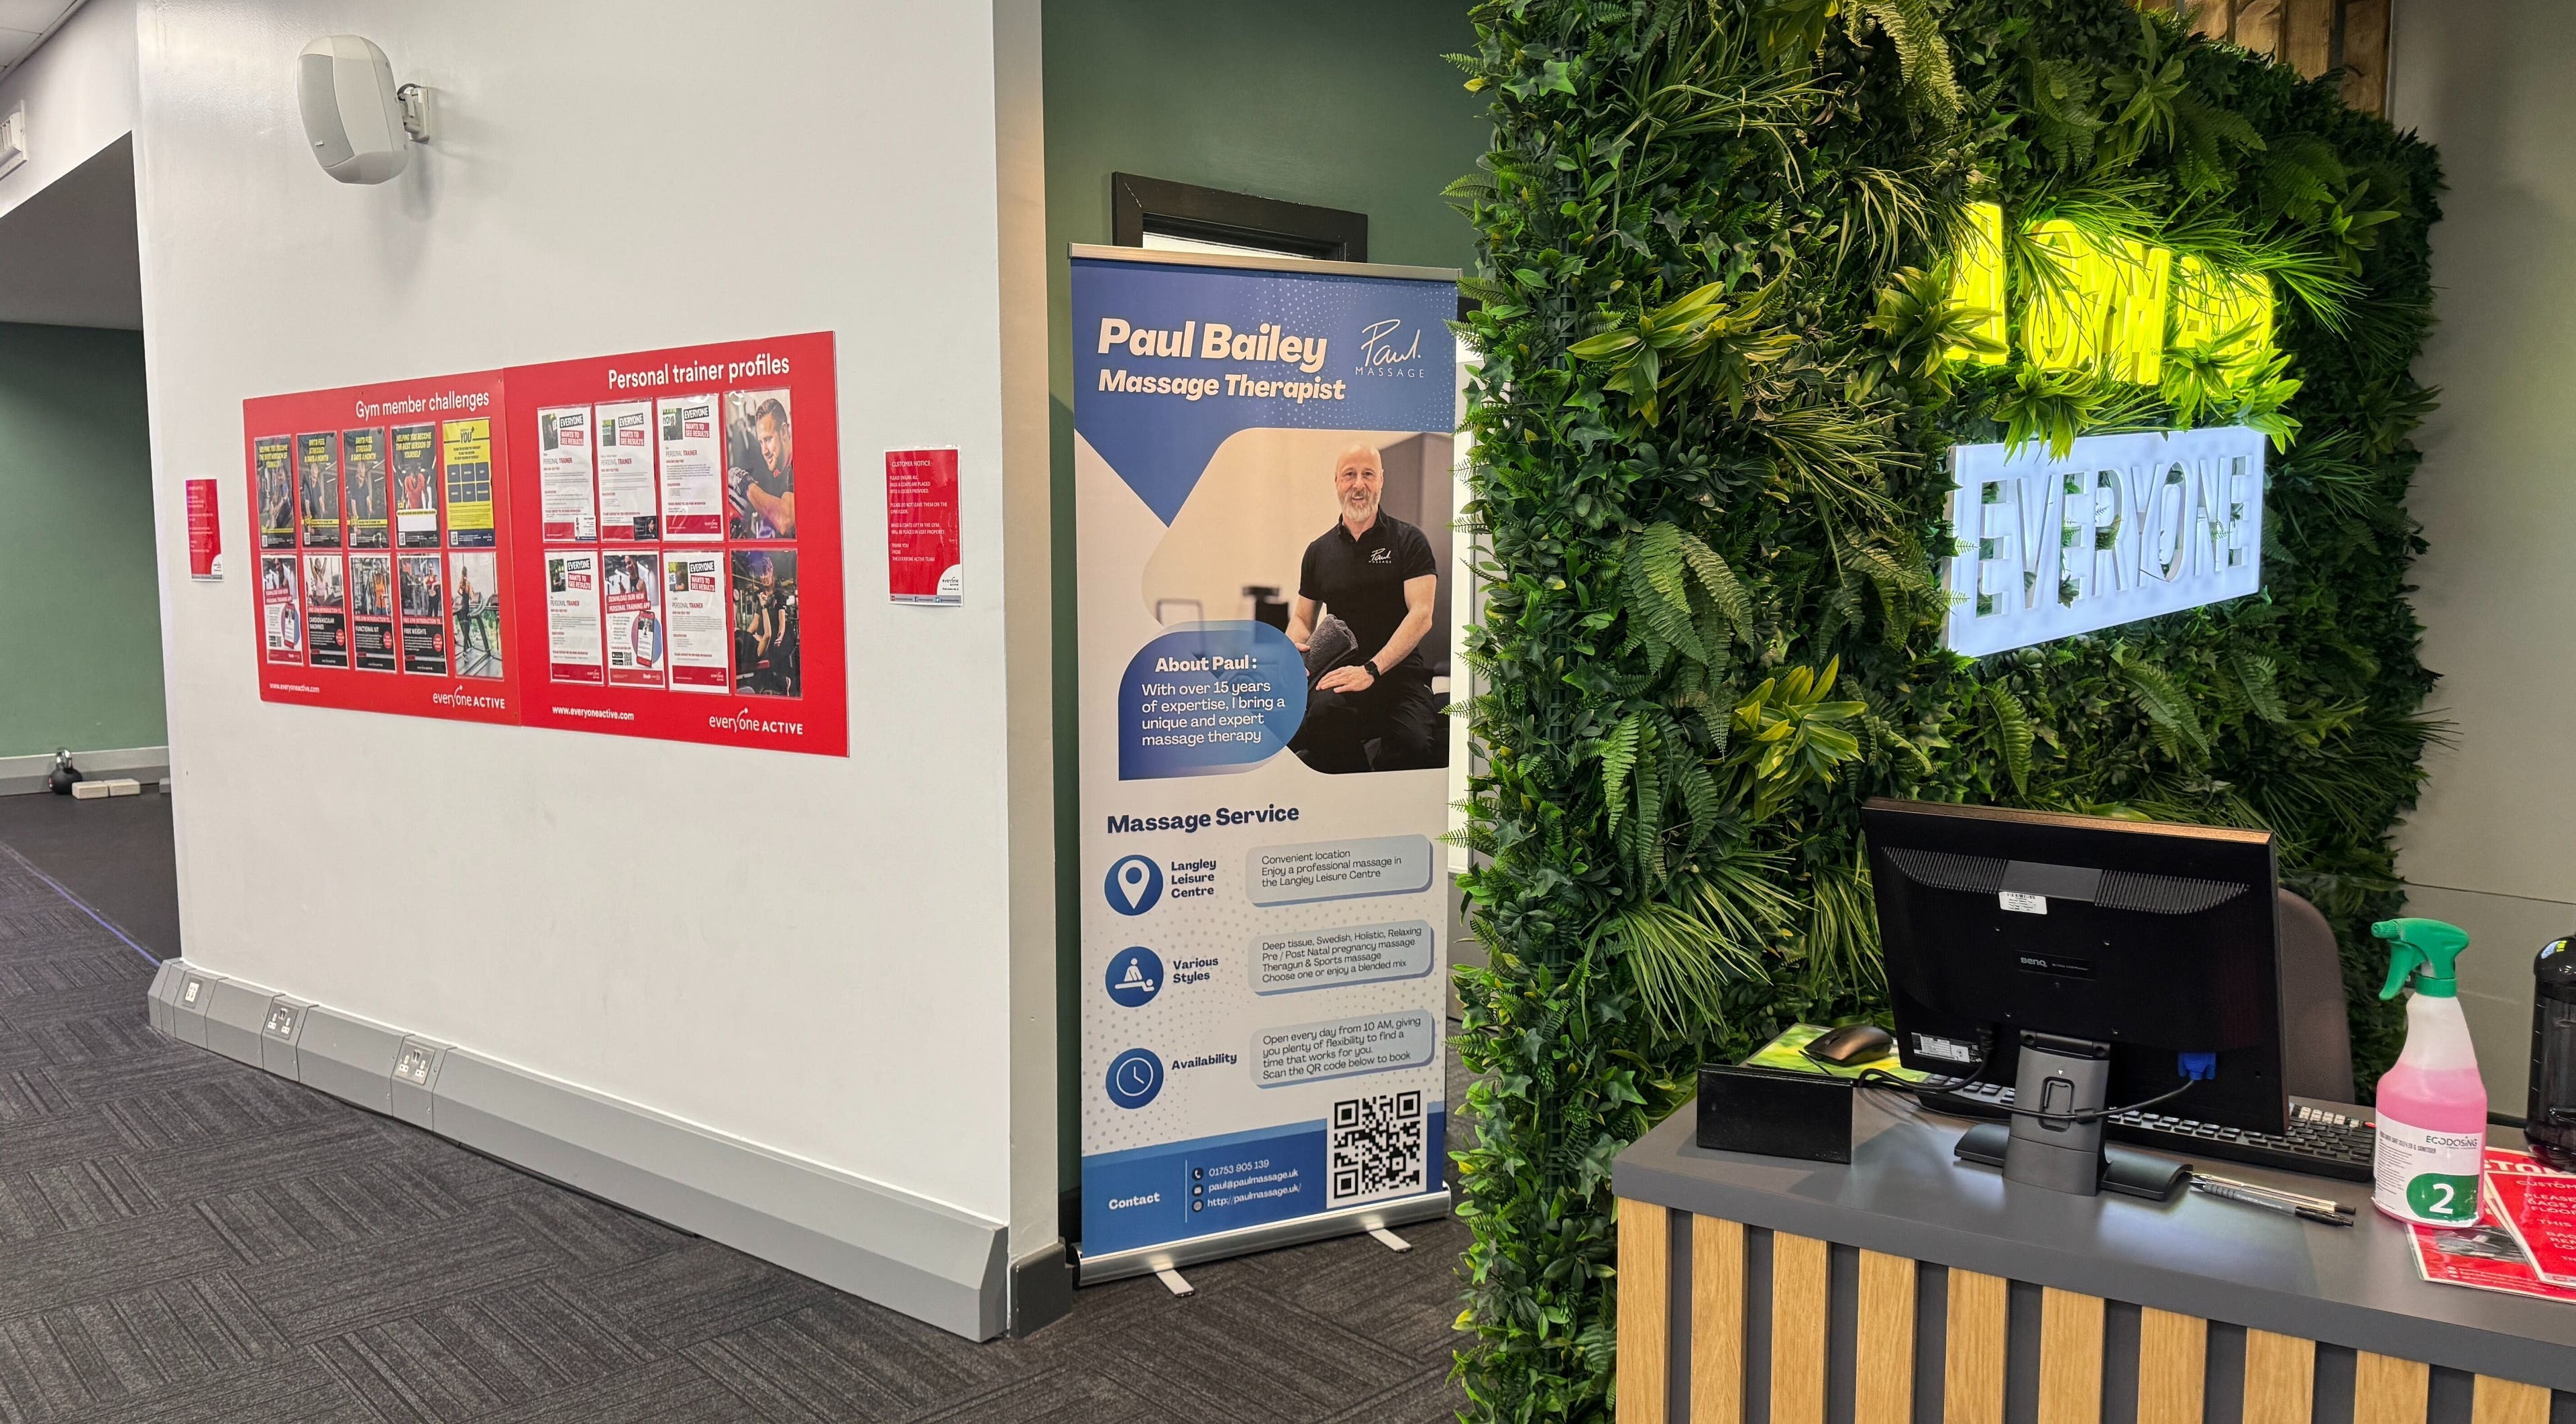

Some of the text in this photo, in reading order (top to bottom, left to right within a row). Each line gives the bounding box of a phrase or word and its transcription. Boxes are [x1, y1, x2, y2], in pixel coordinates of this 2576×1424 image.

[1097, 317, 1328, 373] Paul Bailey
[608, 353, 790, 390] Personal trainer profiles
[1355, 367, 1424, 378] MASSAGE
[1098, 369, 1346, 404] Massage Therapist
[356, 390, 489, 421] Gym member challenges
[685, 407, 708, 419] EVERYONE
[561, 415, 583, 427] EVERYONE
[619, 415, 643, 427] EVERYONE
[1976, 455, 2252, 619] EVERYONE
[568, 559, 590, 570] EVERYONE
[690, 562, 713, 572] EVERYONE
[1155, 657, 1209, 672] About
[269, 682, 320, 694] www.everyoneactive.com
[433, 684, 505, 709] everyone ACTIVE
[1142, 681, 1271, 696] With over 15 years
[552, 705, 635, 721] www.everyoneactive.com
[1142, 696, 1285, 714] of expertise, I bring a
[708, 708, 804, 735] everyone ACTIVE
[1142, 713, 1264, 731] unique and expert
[1142, 730, 1262, 747] massage therapy
[1108, 804, 1299, 833] Massage Service
[1171, 859, 1216, 872] Langley
[1262, 849, 1350, 865] Convenient location
[1262, 867, 1286, 878] Enjoy
[1296, 860, 1350, 875] professional
[1352, 858, 1392, 869] massage
[1394, 857, 1401, 865] in
[1171, 873, 1215, 885] Leisure
[1262, 869, 1381, 887] the Langley Leisure Centre
[1171, 886, 1214, 898] Centre
[1263, 927, 1421, 950] Deep tissue, Swedish, Holistic, Relaxing
[1263, 952, 1277, 961] Pre
[1285, 950, 1305, 959] Post
[1307, 946, 1330, 956] Natal
[1332, 943, 1376, 954] pregnancy
[1378, 939, 1415, 948] massage
[1173, 958, 1218, 970] Various
[1263, 961, 1303, 972] Theragun
[1314, 956, 1342, 967] Sports
[1344, 952, 1381, 963] massage
[1263, 973, 1295, 983] Choose
[1297, 971, 1313, 979] one
[1327, 967, 1349, 977] enjoy
[1358, 962, 1391, 972] blended
[1393, 959, 1407, 968] mix
[1173, 971, 1210, 984] Styles
[1263, 1018, 1421, 1045] Open every day from 10 AM, giving
[1263, 1048, 1280, 1058] you
[1283, 1042, 1311, 1056] plenty
[1313, 1040, 1324, 1049] of
[1326, 1035, 1365, 1048] flexibility
[1367, 1034, 1377, 1042] to
[1379, 1031, 1396, 1040] find
[1171, 1052, 1237, 1070] Availability
[1263, 1046, 1373, 1068] time that works for you.
[1263, 1052, 1411, 1079] Scan the QR code below to book
[1209, 1159, 1269, 1176] 01753 905 139
[1208, 1168, 1299, 1193] paul@paulmassage.uk
[1108, 1192, 1161, 1210] Contact
[2429, 1183, 2455, 1214] 2
